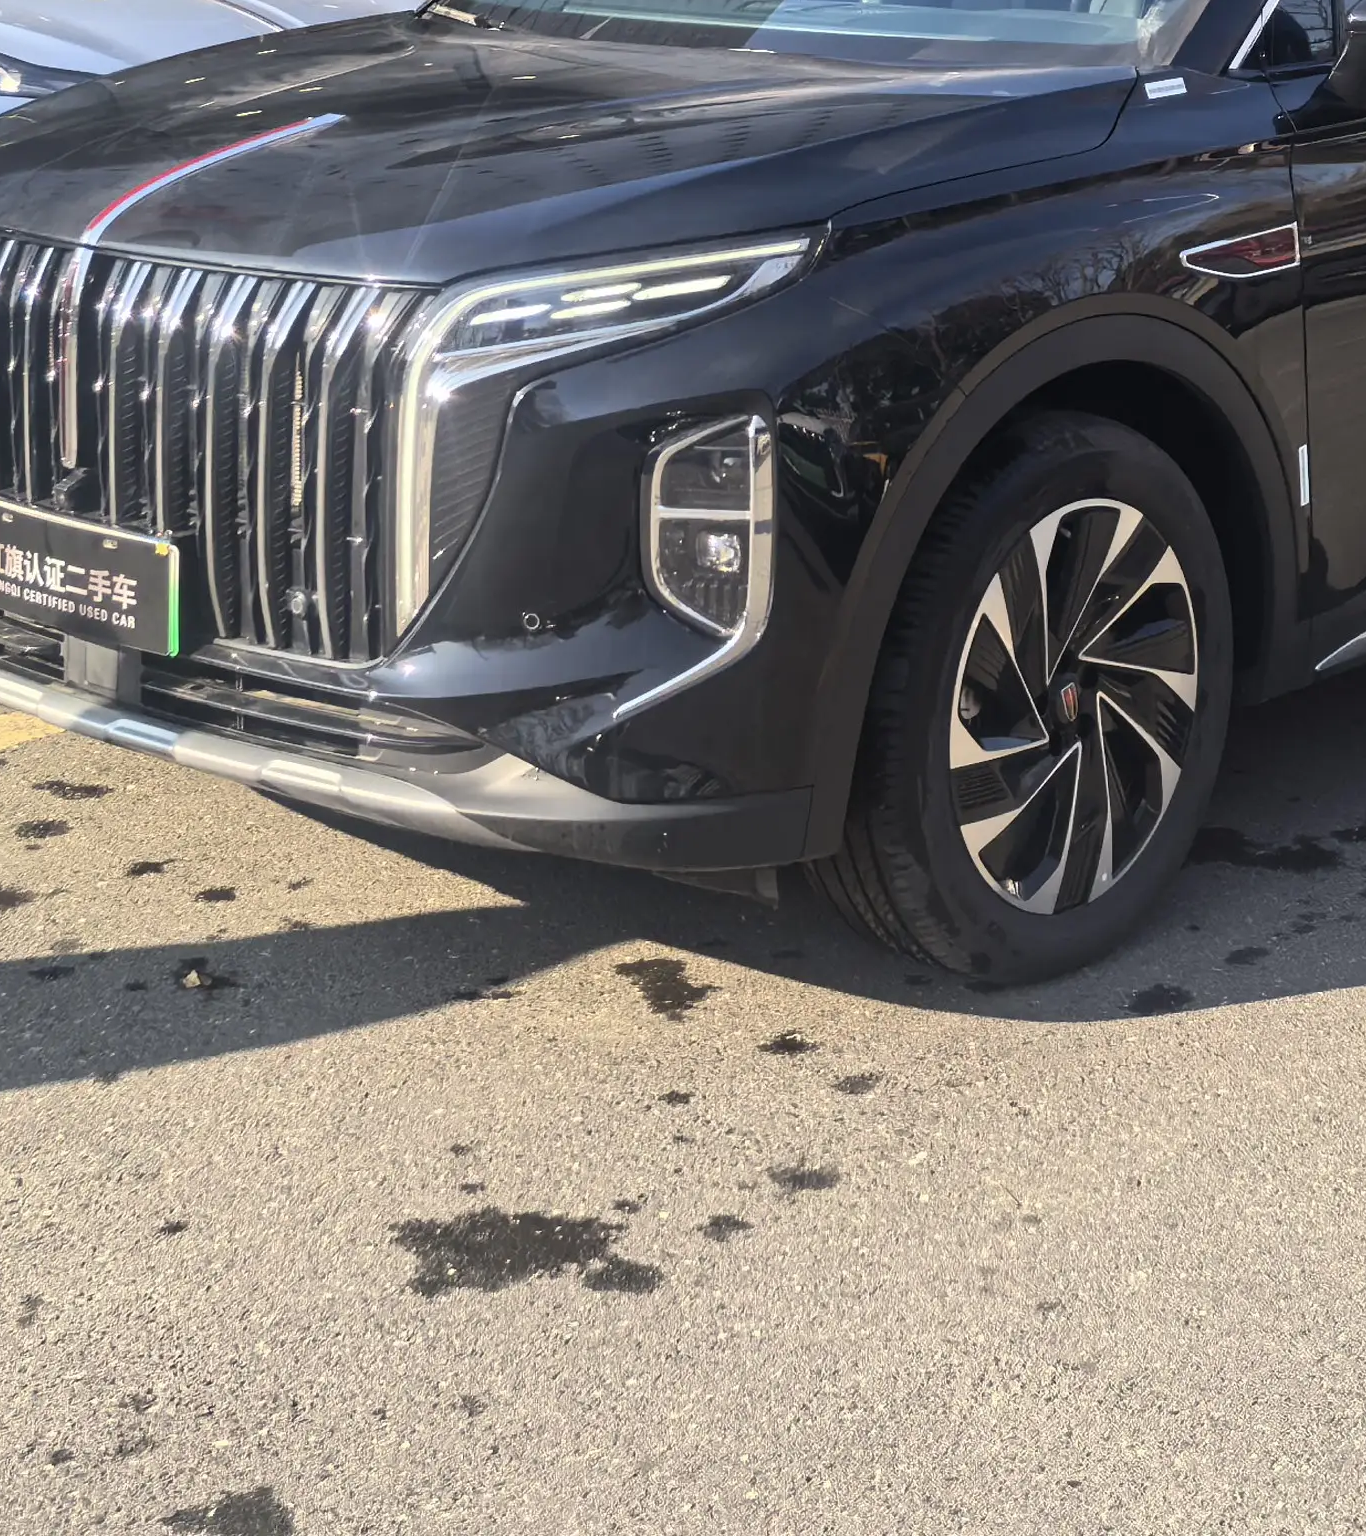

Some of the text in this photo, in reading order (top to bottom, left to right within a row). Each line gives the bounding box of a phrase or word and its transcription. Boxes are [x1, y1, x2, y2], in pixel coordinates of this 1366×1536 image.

[23, 588, 75, 614] CERTIFIED
[79, 604, 108, 622] USED
[111, 612, 136, 629] CAR
